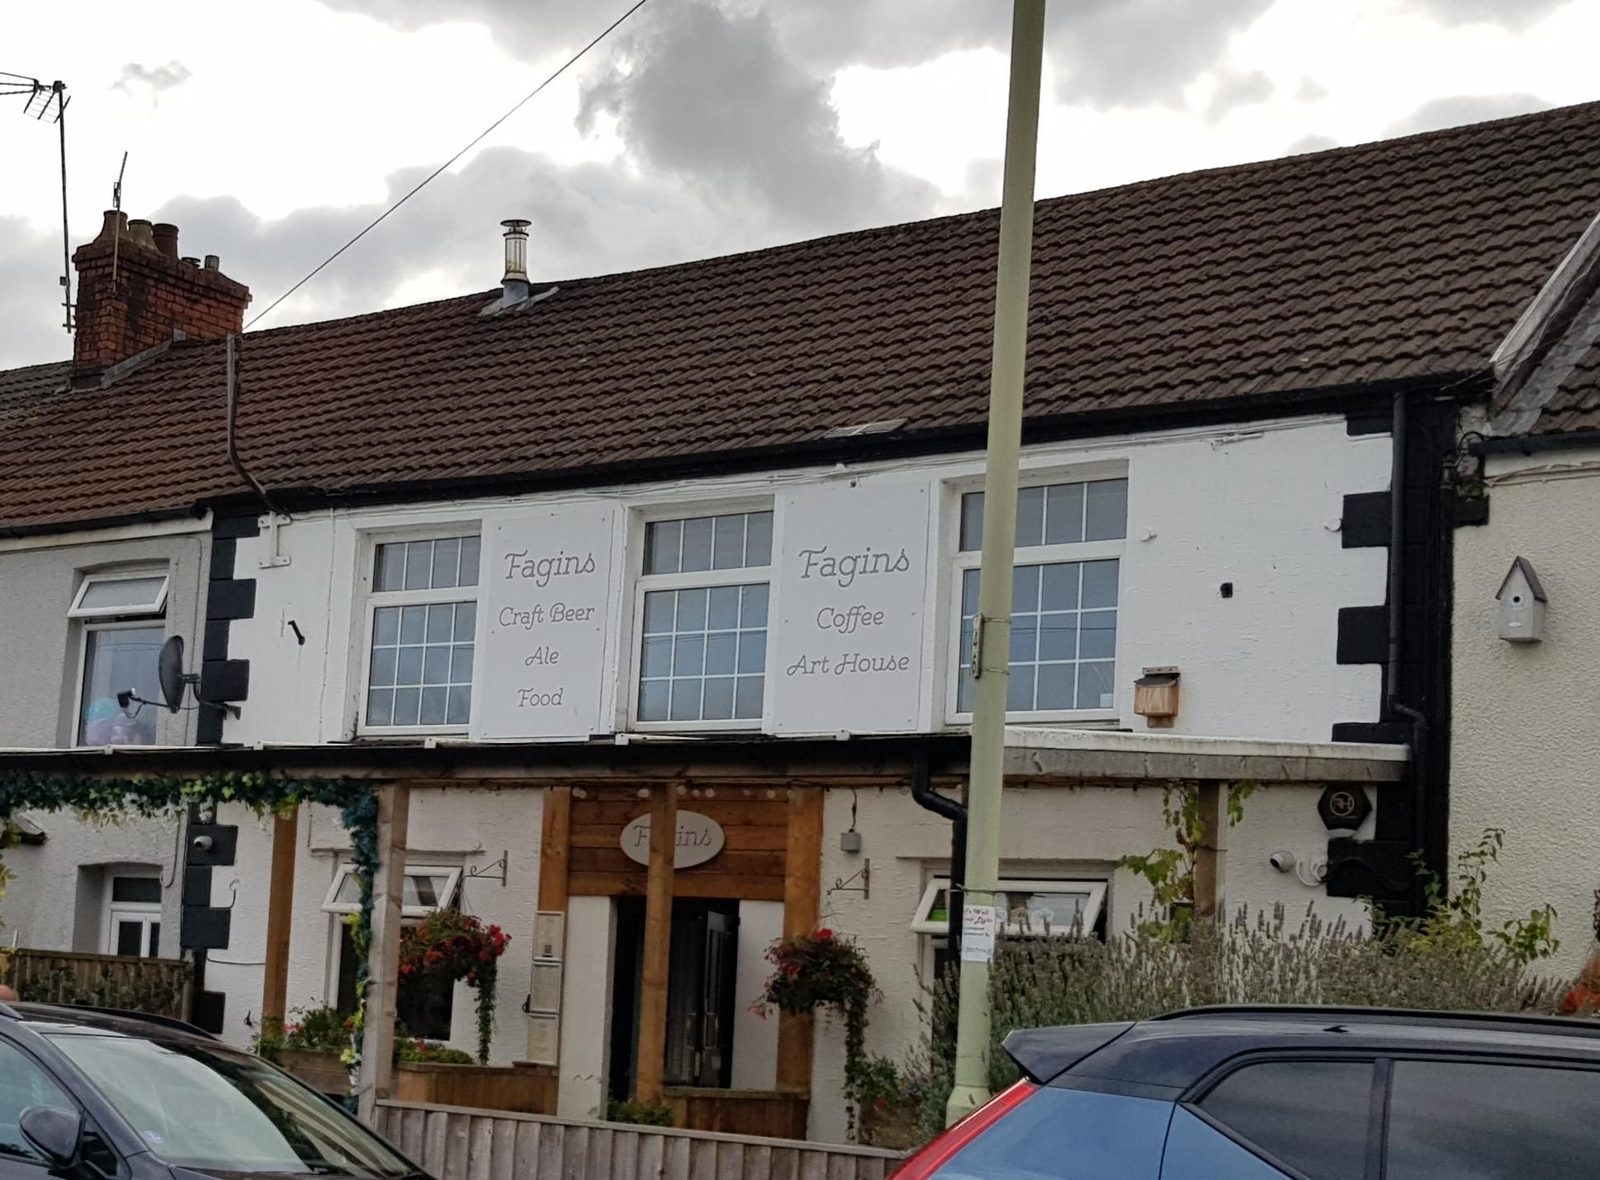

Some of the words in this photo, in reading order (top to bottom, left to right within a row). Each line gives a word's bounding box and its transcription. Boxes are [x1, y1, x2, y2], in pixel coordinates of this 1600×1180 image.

[504, 549, 596, 587] Fagins
[798, 546, 910, 588] Fagins
[499, 603, 545, 630] Craft
[550, 602, 595, 622] Beer
[816, 604, 885, 634] Coffee
[524, 646, 559, 666] Ale
[786, 654, 830, 676] Art
[833, 653, 910, 675] House
[517, 687, 564, 708] Food
[632, 824, 712, 848] Fins
